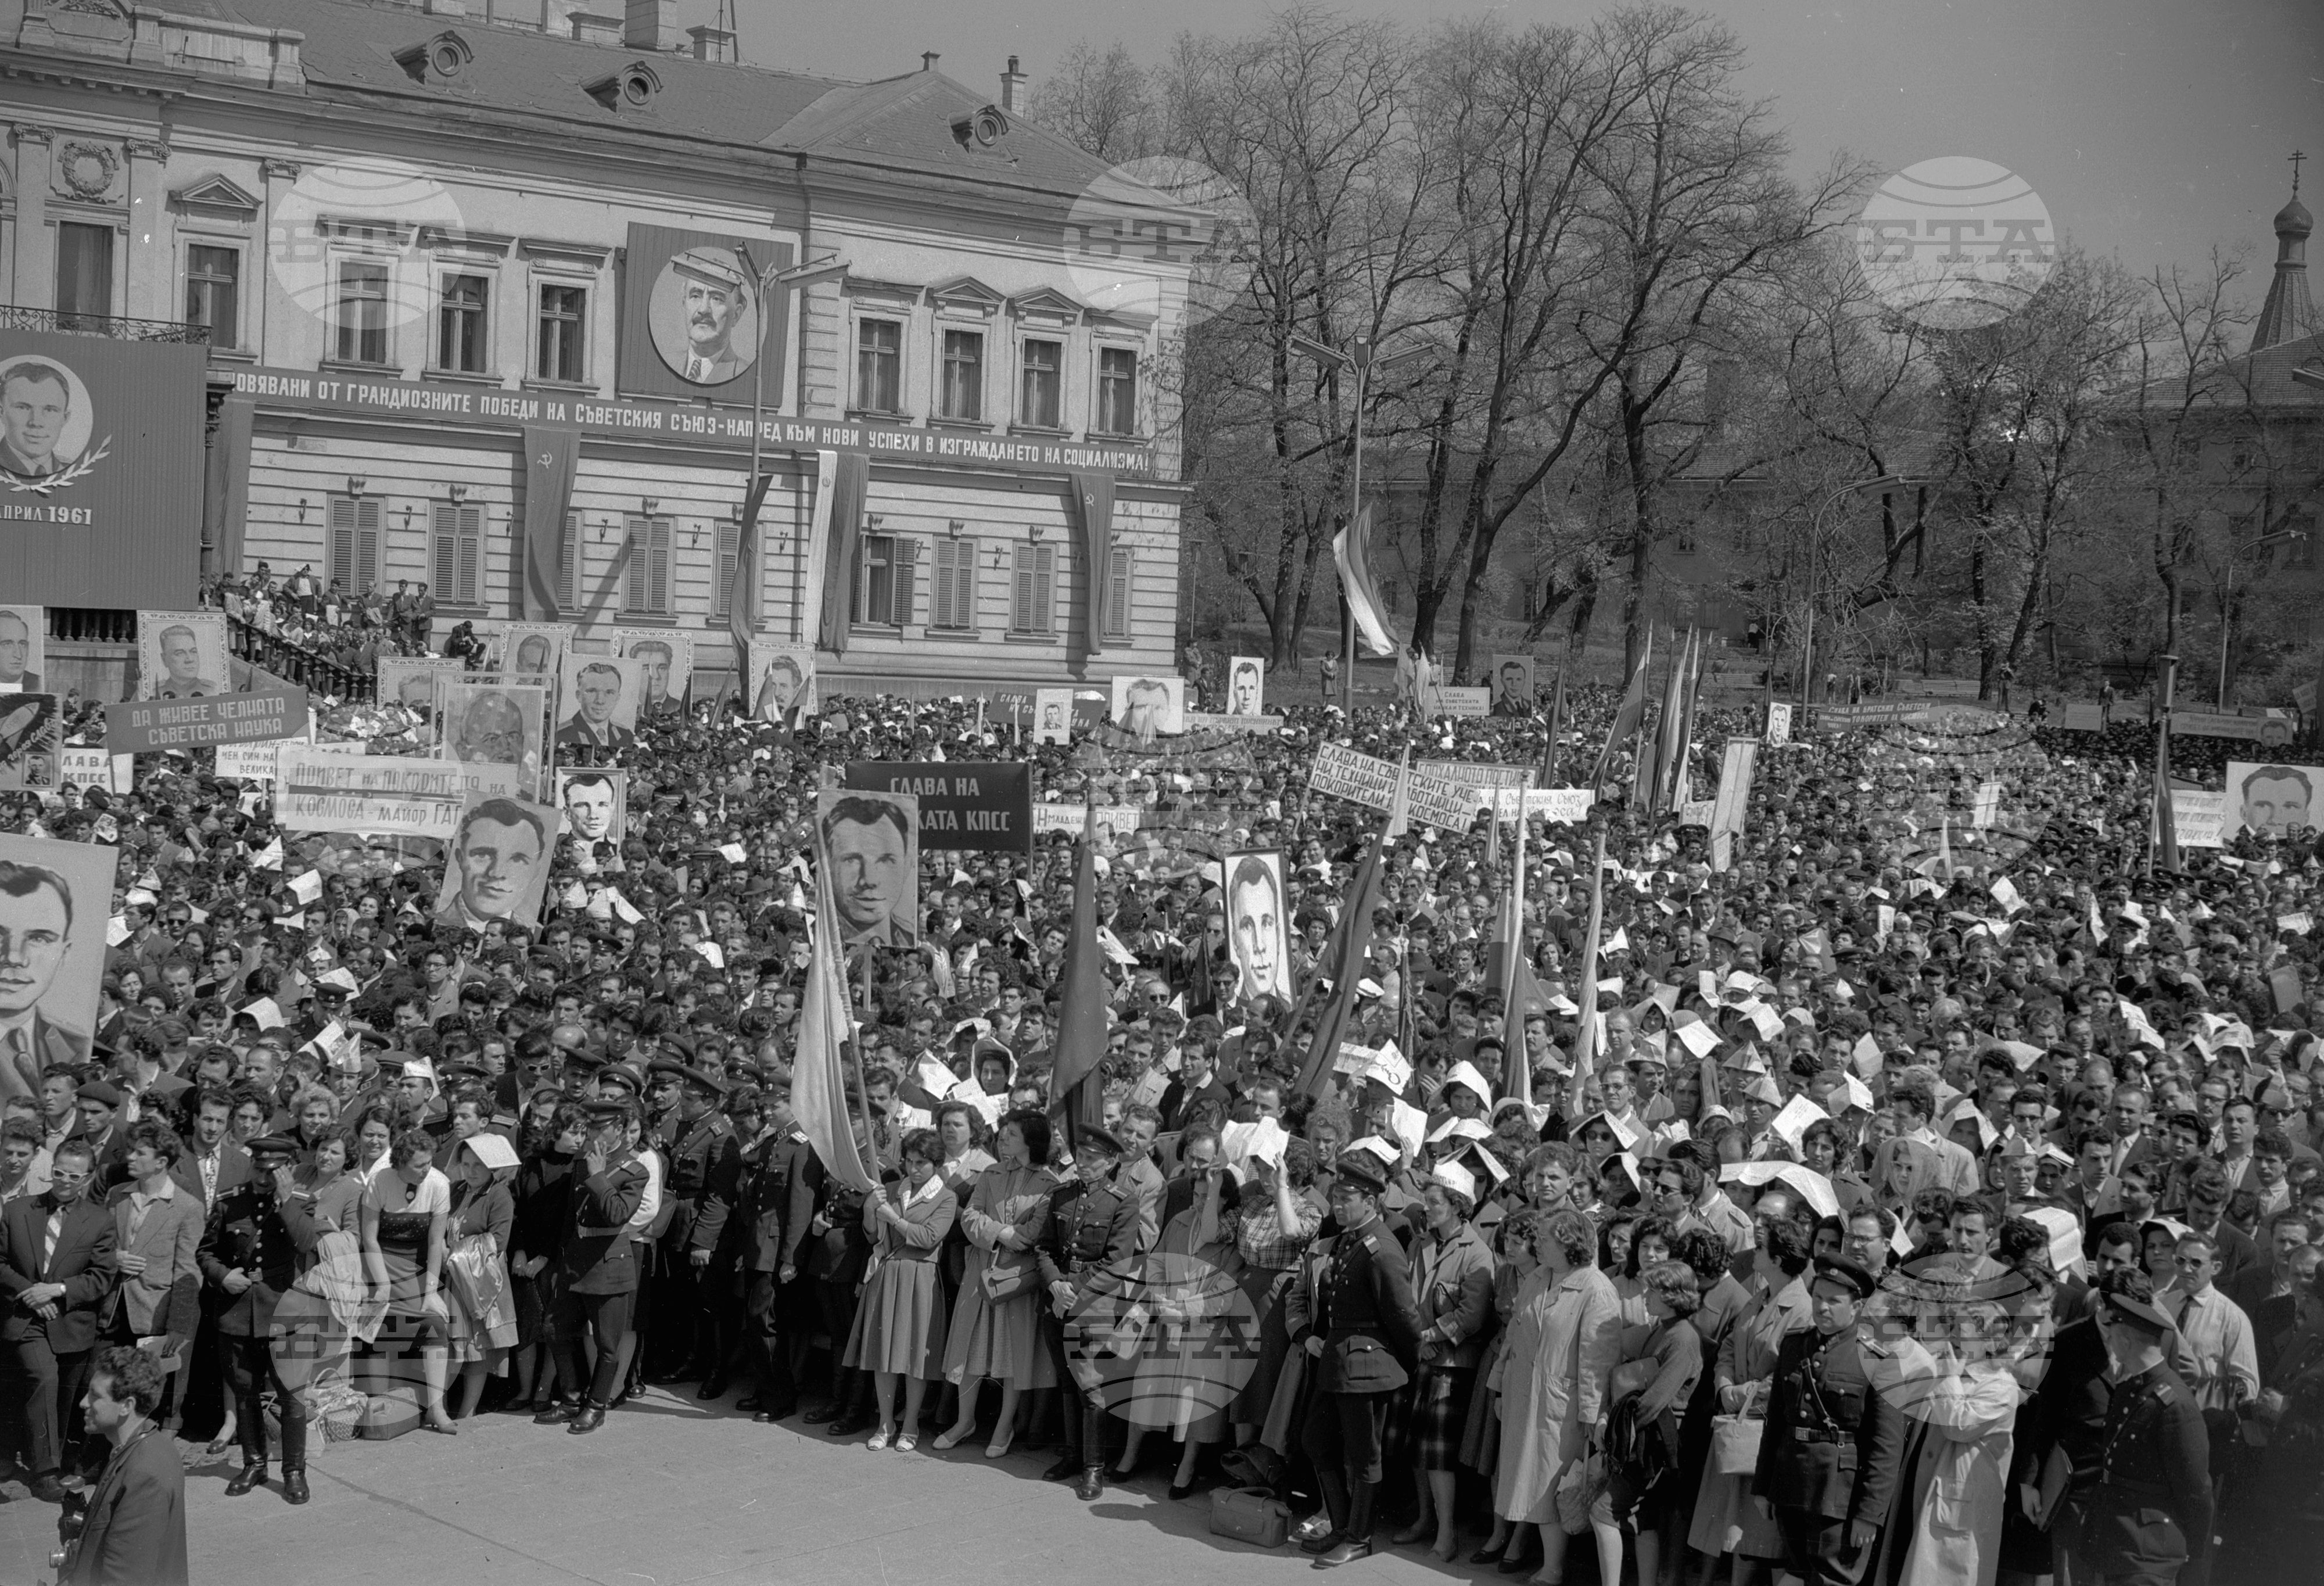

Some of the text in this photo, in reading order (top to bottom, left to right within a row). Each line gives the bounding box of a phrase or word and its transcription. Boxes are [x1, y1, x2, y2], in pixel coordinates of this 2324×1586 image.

[231, 372, 310, 399] ОВЯВАНИ
[318, 381, 340, 400] ОТ
[347, 383, 471, 413] ГРАНДИОЗНИТЕ
[480, 396, 538, 420] ПОБЕДИ
[547, 402, 565, 422] НА
[575, 403, 662, 429] СЪВЕТСКИЯ
[787, 424, 815, 443] КЪМ
[823, 428, 859, 446] НОВИ
[869, 432, 919, 452] УСПЕХИ
[926, 436, 933, 452] В
[940, 438, 1039, 462] ИЗГРАЖДАНЕТО
[1045, 446, 1060, 464] НА
[1064, 448, 1149, 471] СОЦИАЛИЗМА!
[0, 505, 92, 525] ПРИЛ 1961
[132, 697, 285, 727] ДА ЖИВЕЕ ЧЕЛНАТА
[148, 723, 227, 745] СЪВЕТСКА
[234, 717, 282, 738] НАУКА
[243, 751, 259, 761] СИН
[1320, 745, 1358, 768] СЛАВА
[1360, 758, 1375, 773] НА
[63, 773, 106, 784] КПСС
[490, 783, 506, 795] НА
[956, 778, 980, 796] НА
[1335, 765, 1387, 791] ТЕХНИЦИ
[295, 794, 364, 819] КОСМОСА
[1312, 774, 1385, 806] ПОКОРИТЕЛИ
[1408, 803, 1468, 831] КОСМОСА!
[966, 810, 1010, 831] КПСС
